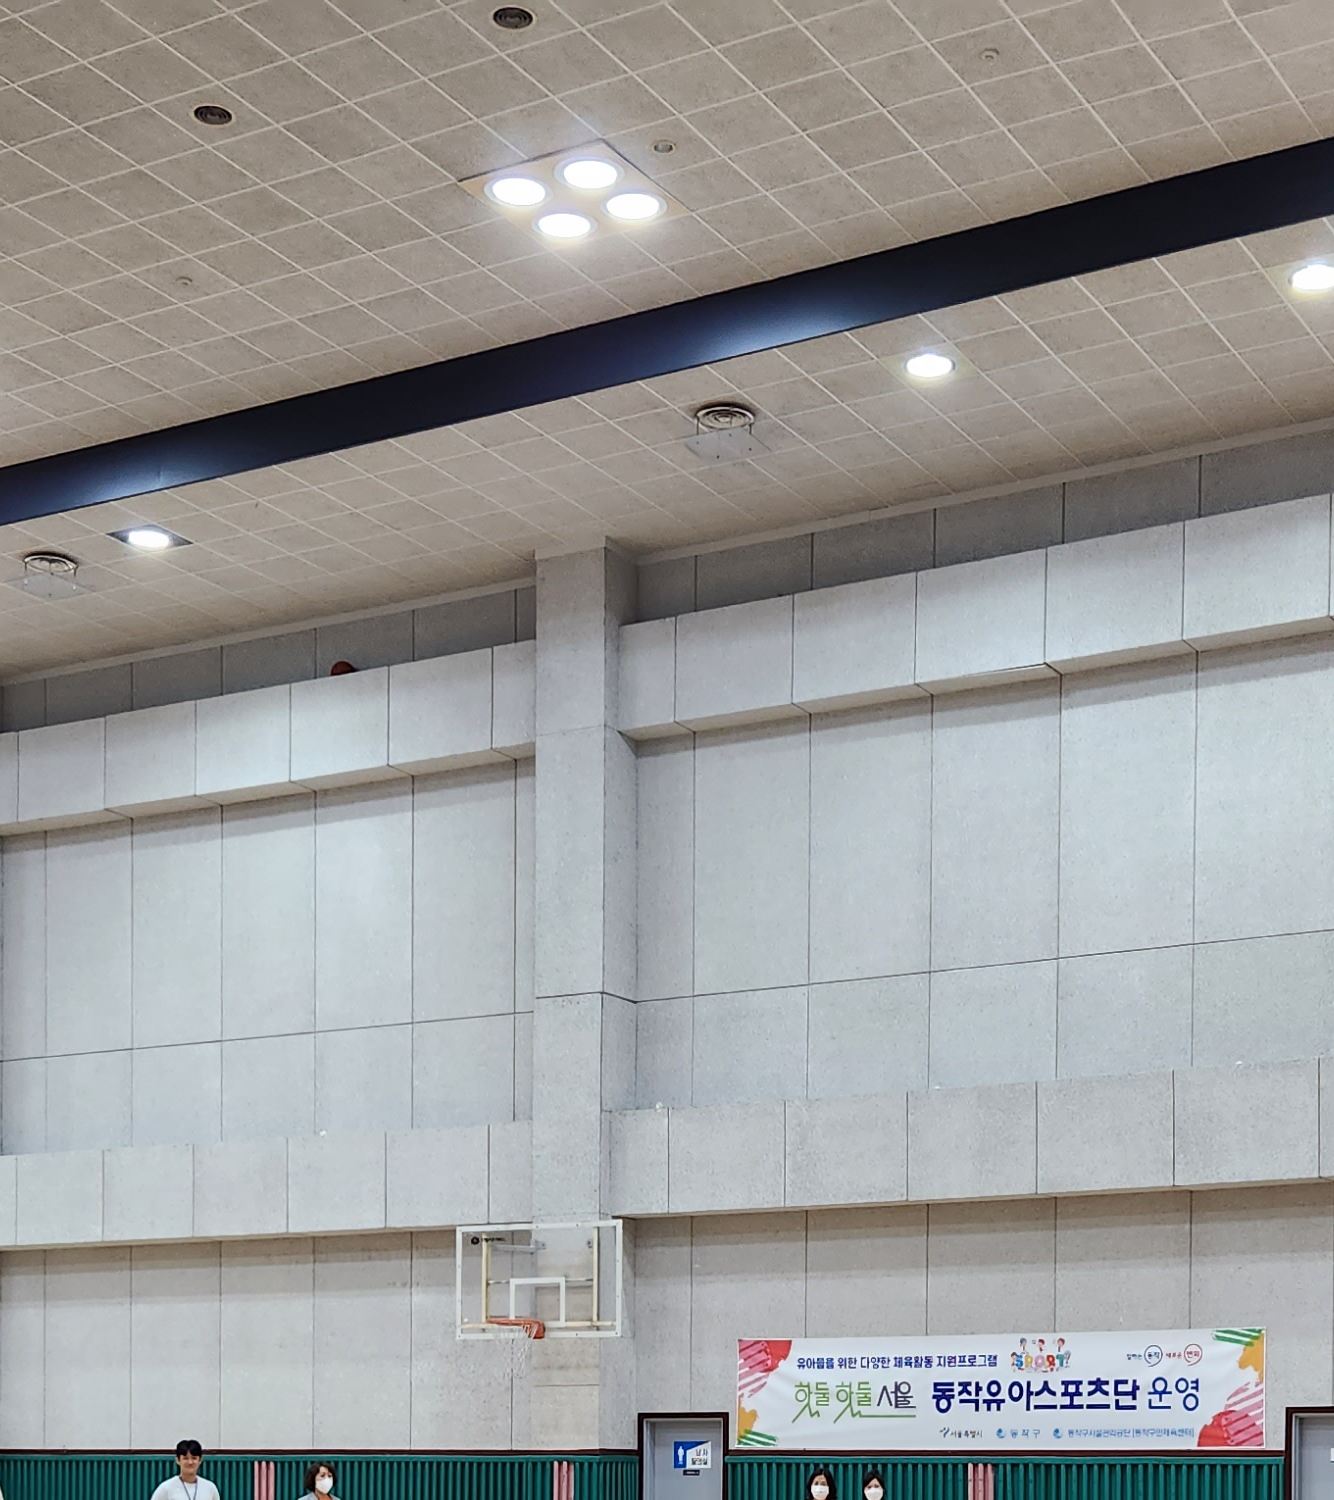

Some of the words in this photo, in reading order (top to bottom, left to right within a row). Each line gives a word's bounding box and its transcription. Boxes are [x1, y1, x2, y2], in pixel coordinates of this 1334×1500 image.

[796, 1356, 835, 1370] 유아들을
[837, 1356, 858, 1369] 위한
[860, 1355, 891, 1369] 다양한
[893, 1354, 934, 1369] 체육활동
[936, 1353, 998, 1368] 지원프로그램
[1015, 1354, 1065, 1368] SPORT
[876, 1380, 917, 1409] 서울
[931, 1377, 1141, 1414] 동작유아스포츠단
[1146, 1376, 1200, 1412] 운영
